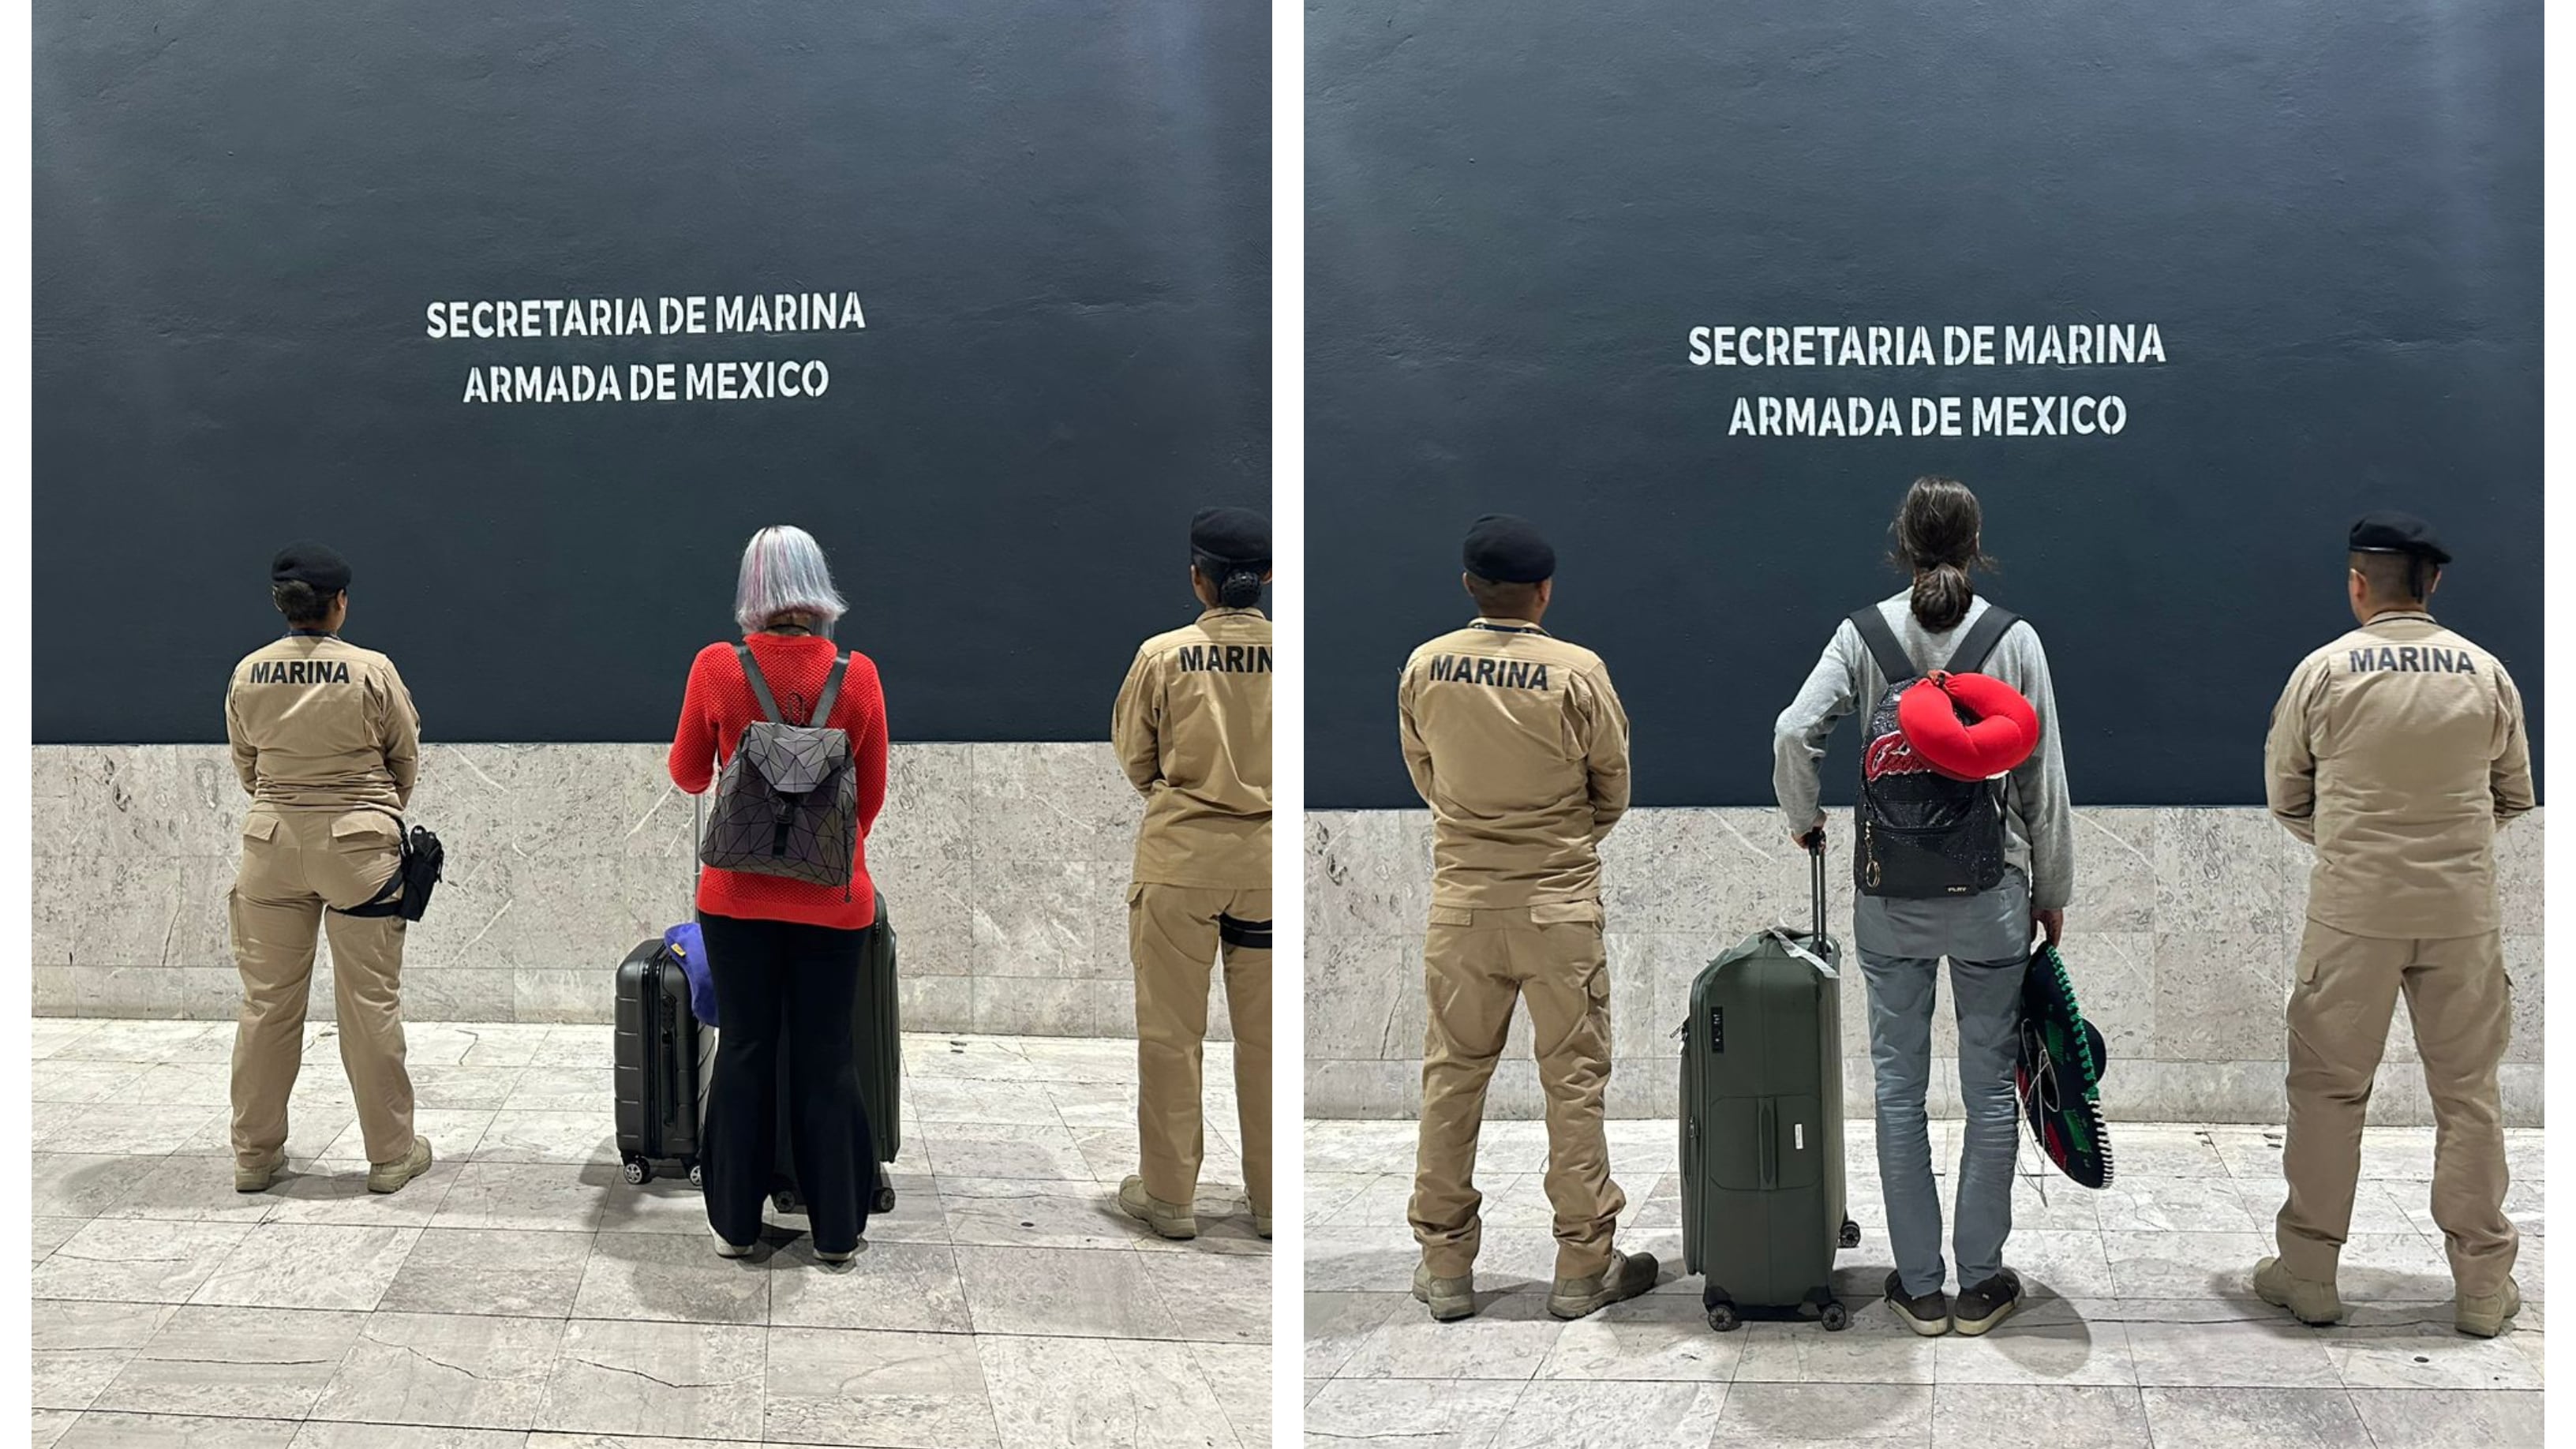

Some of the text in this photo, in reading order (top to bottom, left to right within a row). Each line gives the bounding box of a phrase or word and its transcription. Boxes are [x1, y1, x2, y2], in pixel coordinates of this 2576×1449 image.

[426, 291, 866, 339] SECRETARIA DE MARINA
[1688, 323, 2166, 366] SECRETARIA DE MARINA
[462, 360, 829, 403] ARMADA DE MEXICO
[1728, 395, 2128, 436] ARMADA DE MEXICO
[249, 661, 350, 684] MARINA
[1429, 654, 1548, 691] MARINA
[2349, 646, 2477, 675] MARINA
